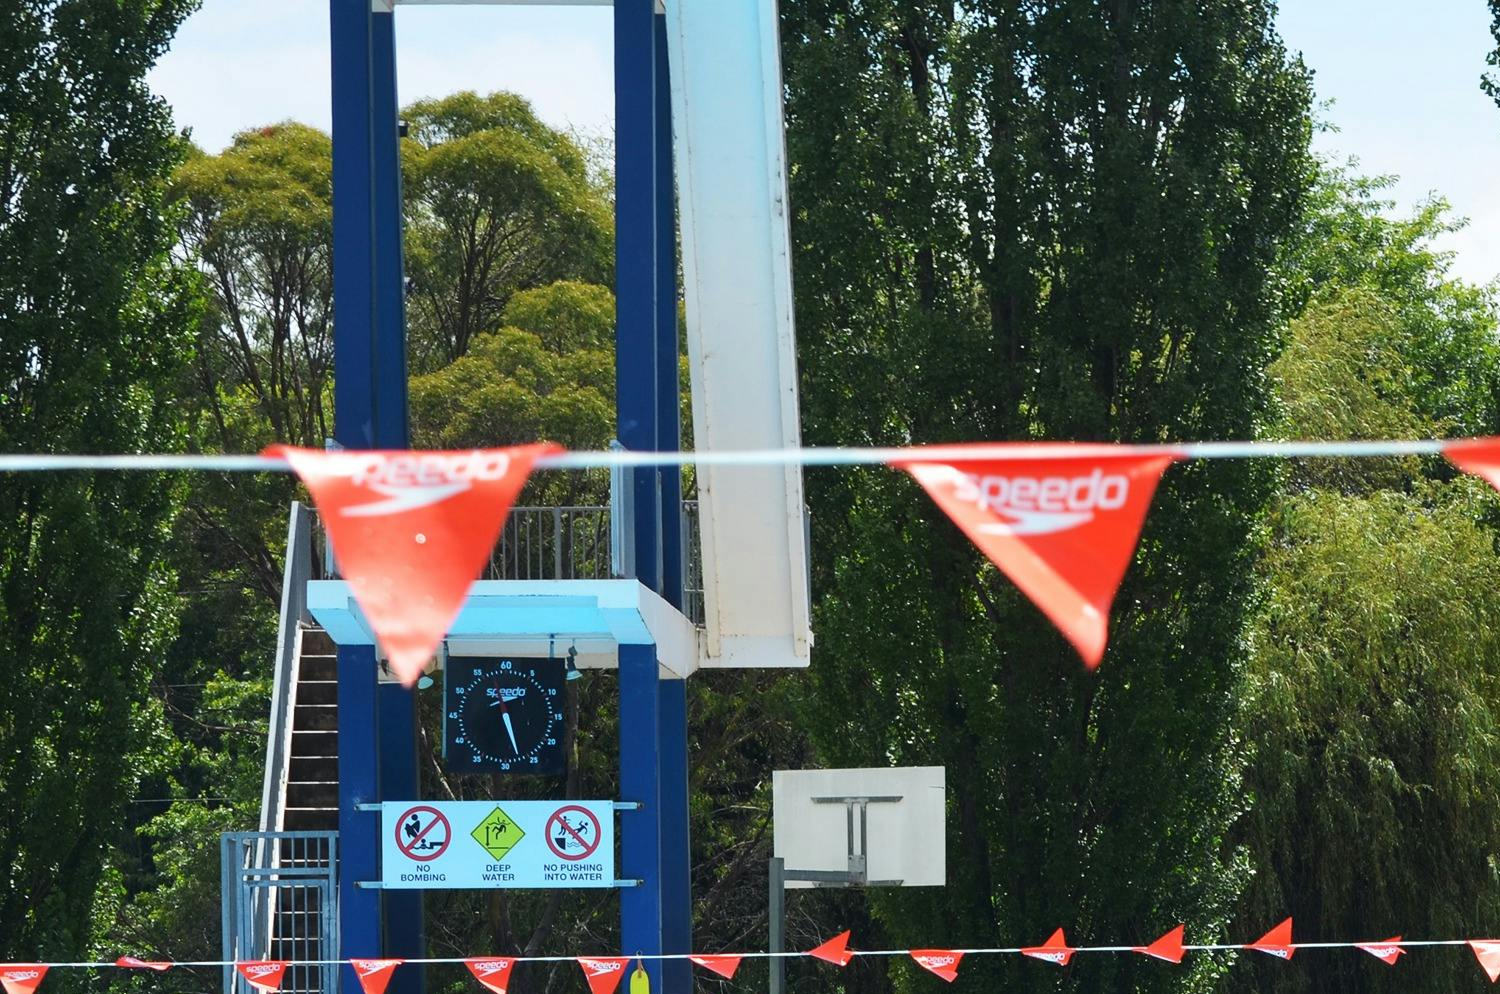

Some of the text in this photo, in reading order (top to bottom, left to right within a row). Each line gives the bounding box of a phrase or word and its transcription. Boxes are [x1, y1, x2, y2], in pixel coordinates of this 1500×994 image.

[326, 451, 510, 485] peedo
[500, 661, 512, 670] 60
[548, 688, 557, 696] 10
[416, 864, 431, 873] NO
[485, 864, 511, 872] DEEP
[543, 863, 603, 872] NO PUSHING
[400, 873, 446, 882] BOMBING
[481, 873, 515, 881] WATER
[544, 873, 602, 881] INTO WATER
[475, 959, 509, 971] speedo
